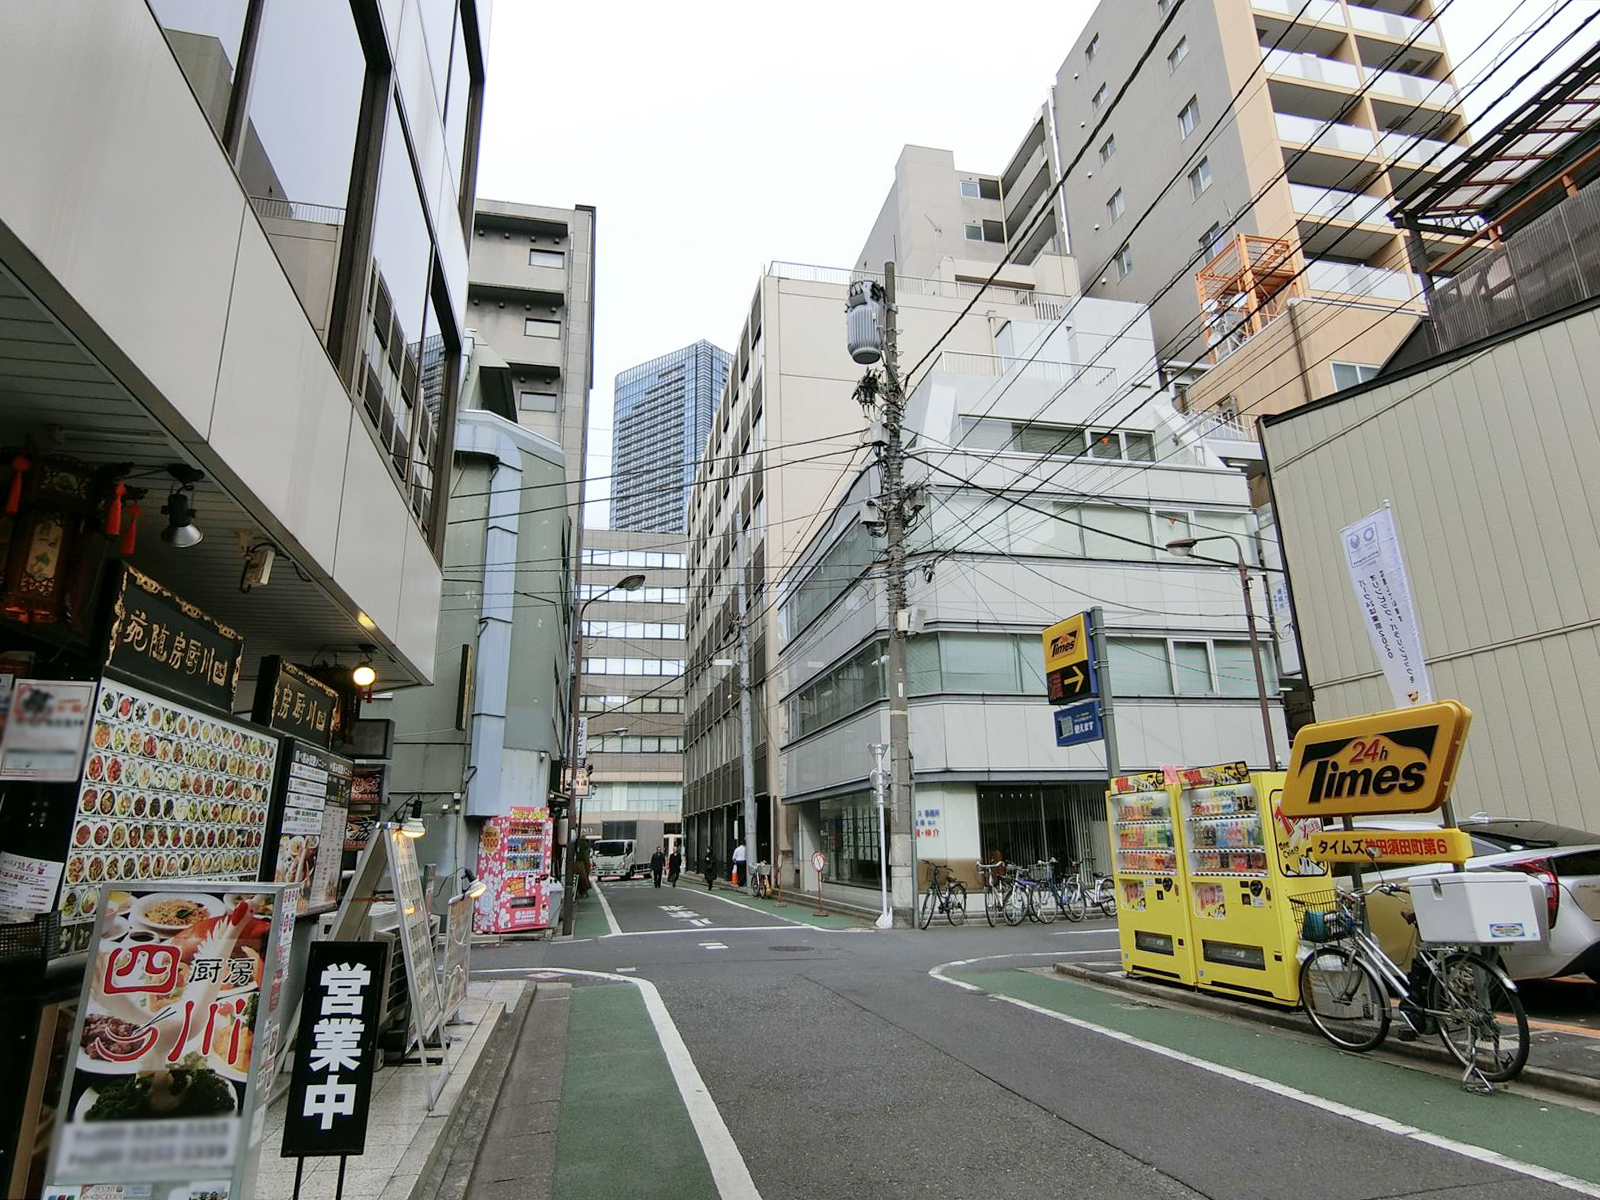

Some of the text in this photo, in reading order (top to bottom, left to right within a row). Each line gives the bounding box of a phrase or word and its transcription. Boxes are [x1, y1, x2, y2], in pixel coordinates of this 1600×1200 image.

[1051, 640, 1075, 658] Times
[1348, 738, 1389, 765] 24h
[1308, 759, 1427, 804] Times
[103, 943, 182, 995] 四
[302, 962, 372, 1130] 営業中
